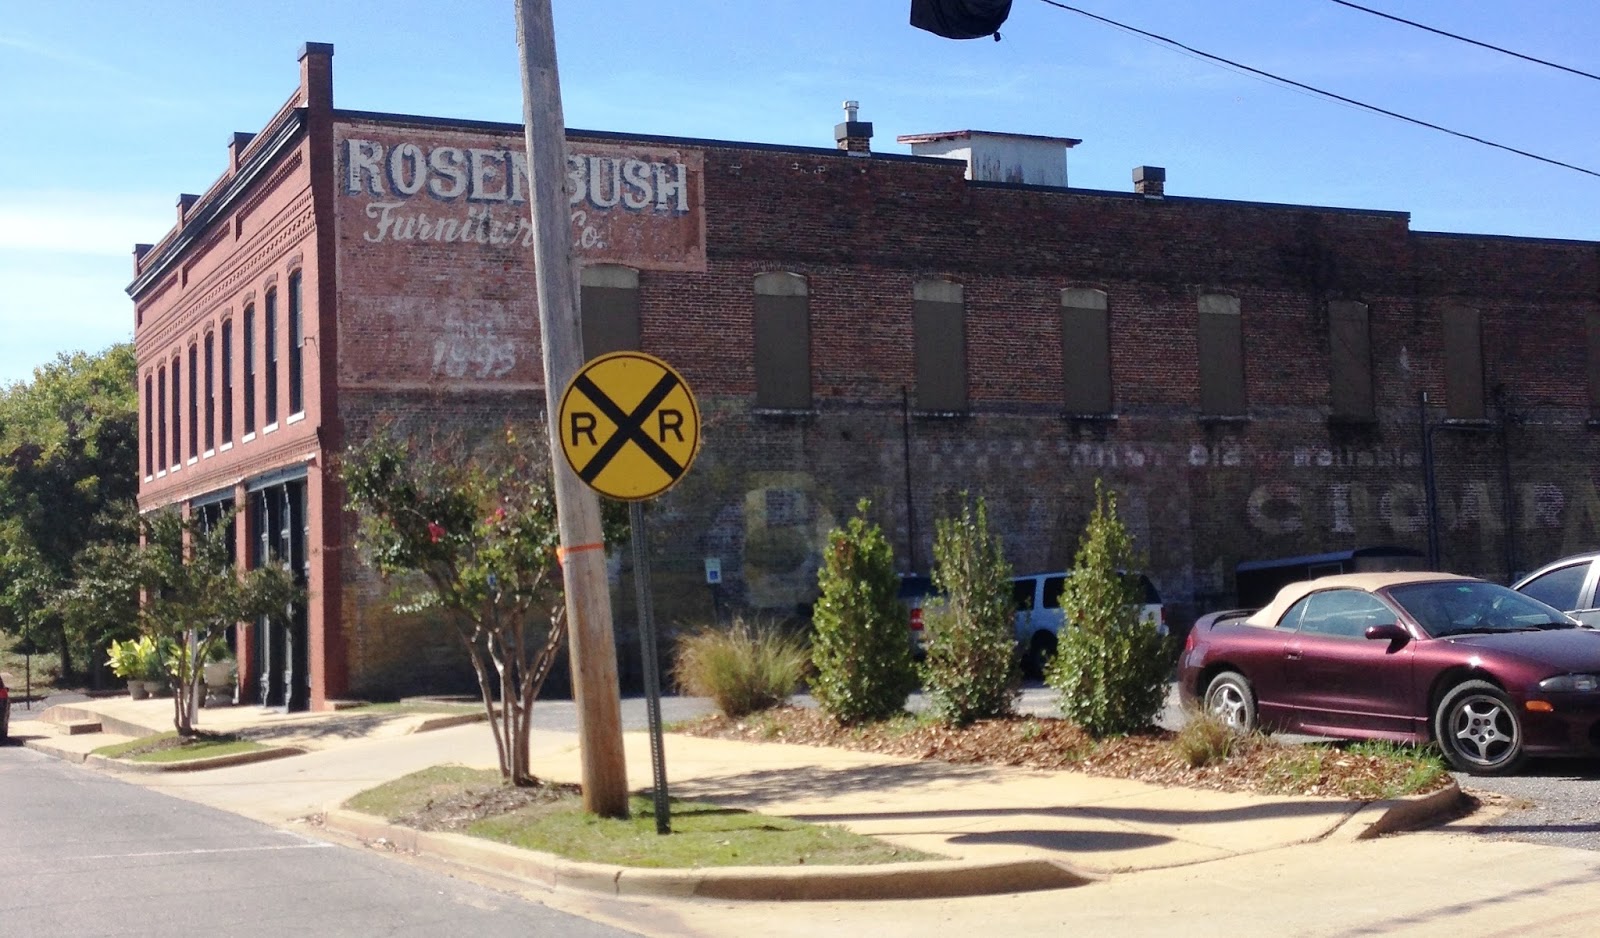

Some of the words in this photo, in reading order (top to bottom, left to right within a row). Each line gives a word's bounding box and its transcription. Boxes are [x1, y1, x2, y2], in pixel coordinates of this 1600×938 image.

[363, 199, 534, 248] Furnitur
[570, 411, 598, 447] R
[658, 408, 685, 443] R
